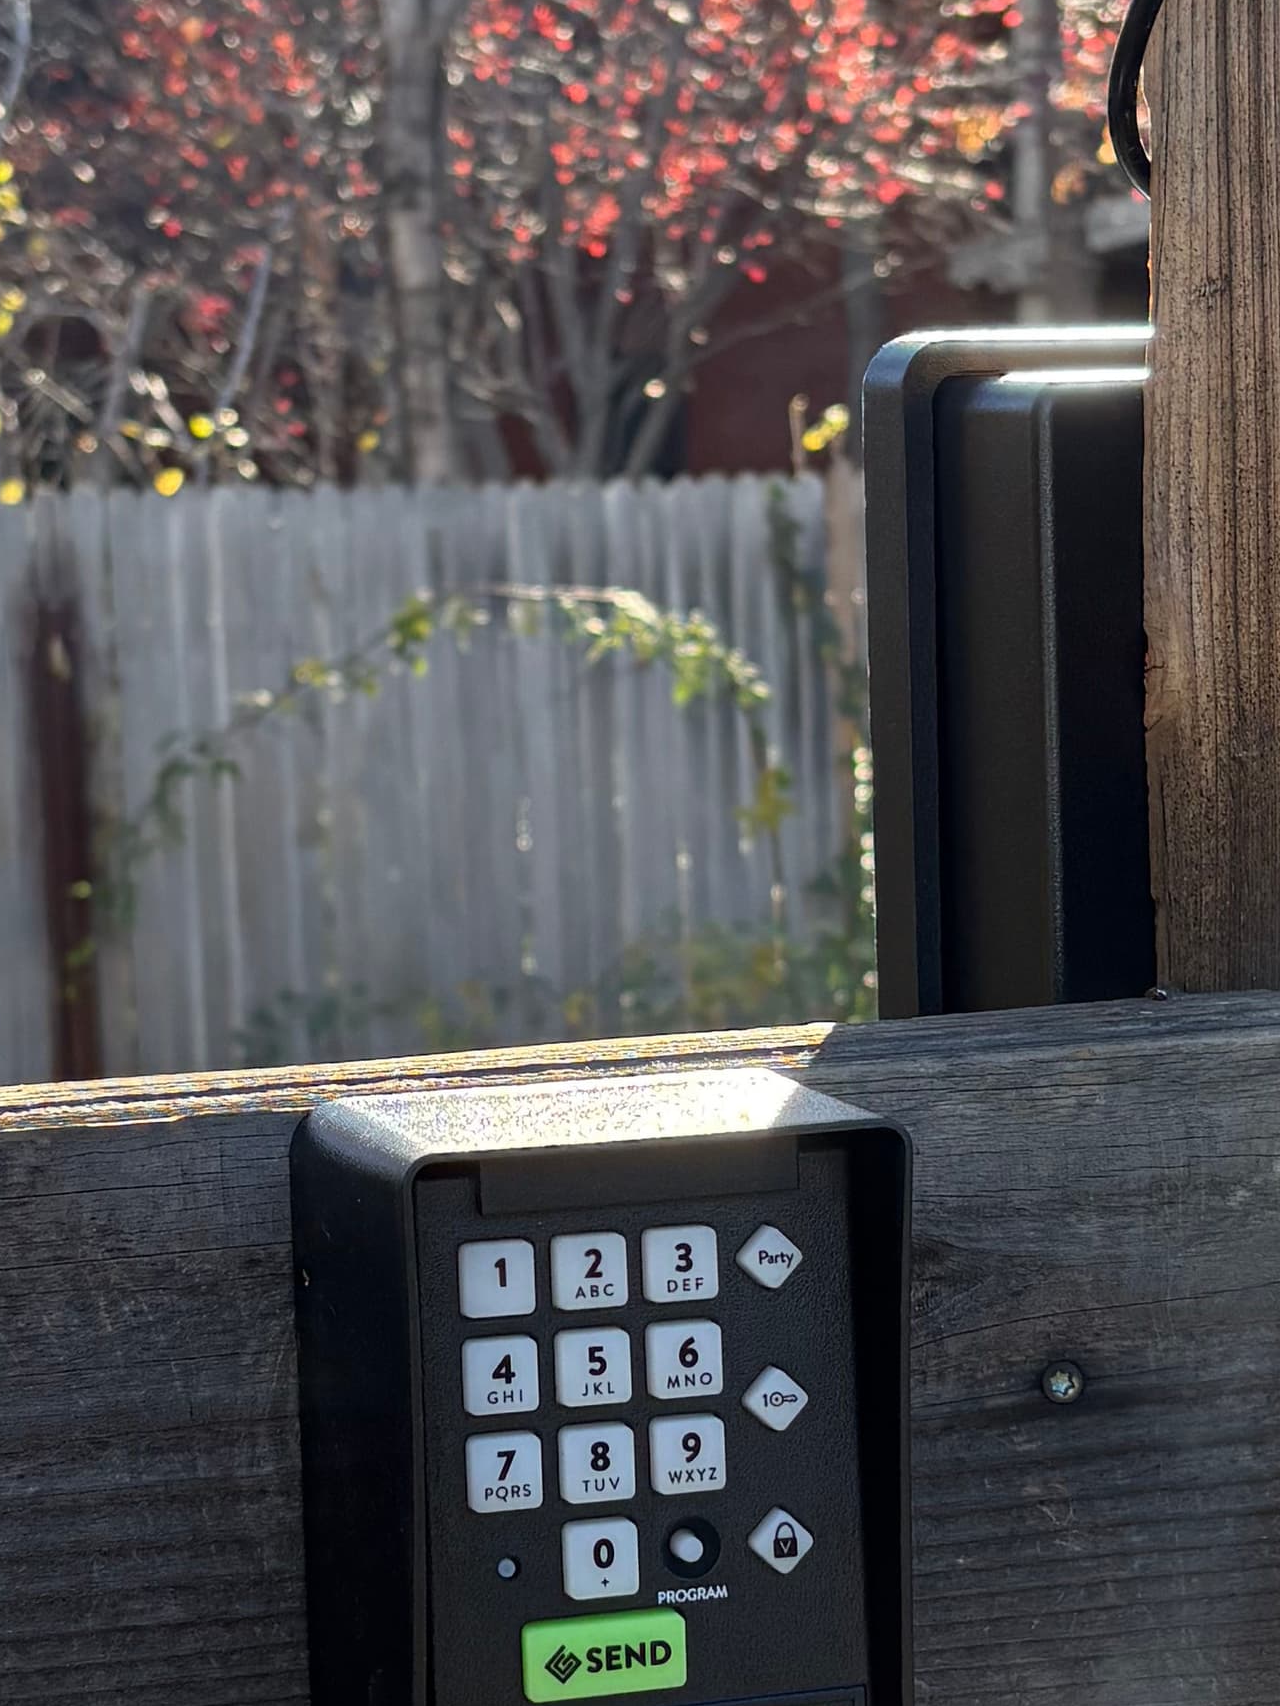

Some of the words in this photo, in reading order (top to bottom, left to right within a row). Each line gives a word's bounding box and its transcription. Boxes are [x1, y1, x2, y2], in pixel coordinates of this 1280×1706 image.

[585, 1249, 603, 1278] 2
[675, 1243, 693, 1272] 3
[759, 1250, 794, 1269] Party
[494, 1258, 506, 1287] 1
[667, 1277, 703, 1293] DEF
[576, 1284, 614, 1299] ABC
[589, 1346, 607, 1376] 5
[679, 1337, 698, 1368] 6
[492, 1354, 515, 1384] 4
[667, 1372, 712, 1389] MNO
[487, 1389, 522, 1404] GHI
[582, 1382, 614, 1396] JKL
[591, 1442, 610, 1471] 8
[682, 1433, 701, 1463] 9
[497, 1450, 516, 1481] 7
[669, 1467, 717, 1483] WXYZ
[485, 1484, 531, 1502] PQRS
[582, 1477, 619, 1493] TUV
[593, 1539, 614, 1568] 0
[657, 1584, 728, 1604] PROGRAM
[586, 1641, 671, 1673] SEND
